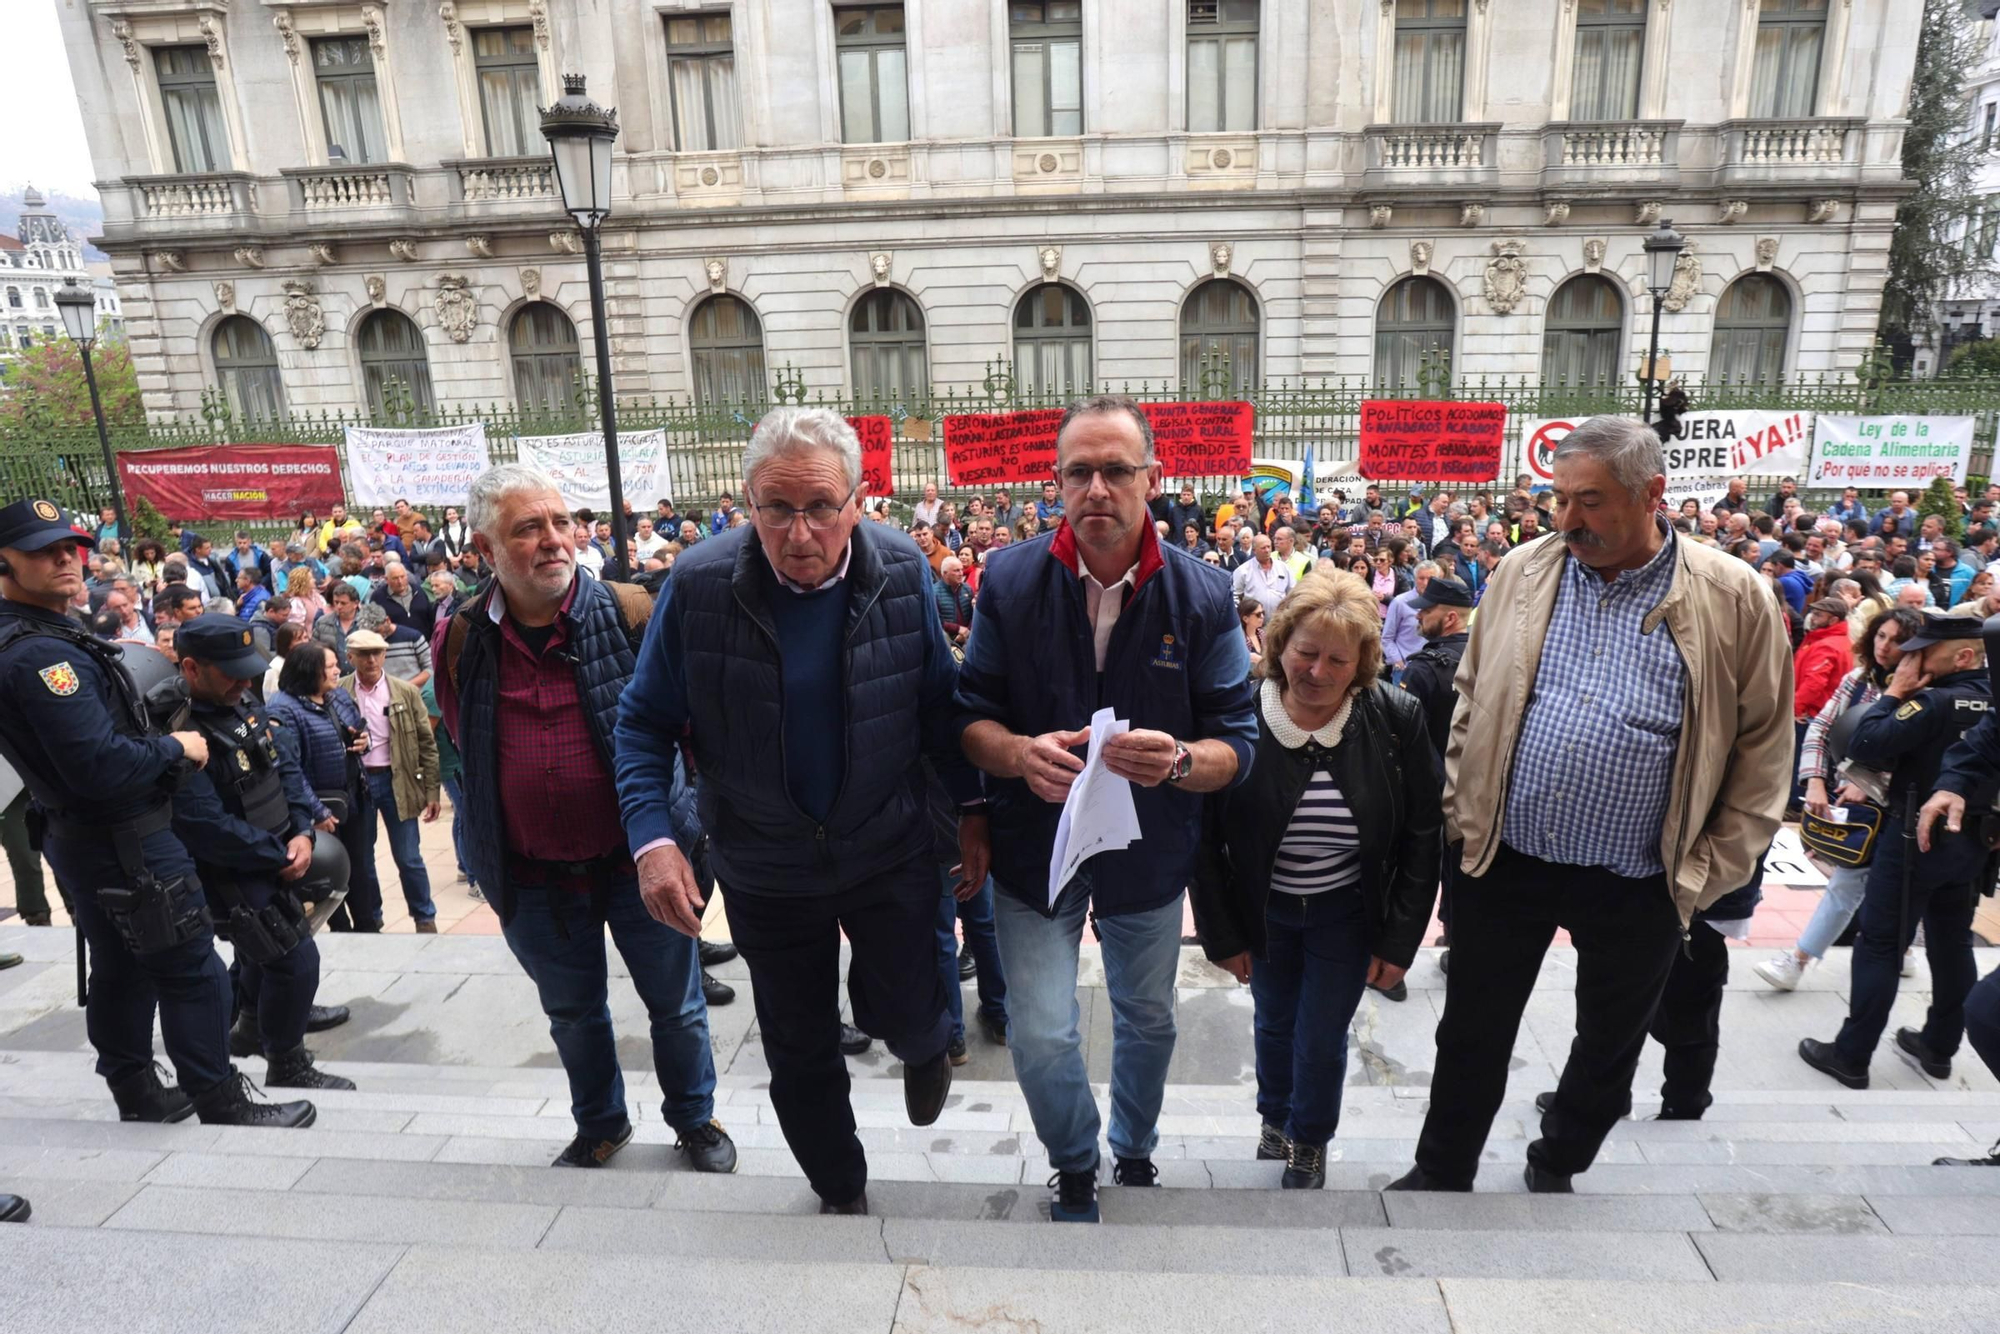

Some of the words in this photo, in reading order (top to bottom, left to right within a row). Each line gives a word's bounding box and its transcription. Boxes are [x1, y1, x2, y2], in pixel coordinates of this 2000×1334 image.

[1154, 405, 1187, 416] JUNTA
[1191, 404, 1242, 416] GENERAL
[1155, 417, 1192, 429] LEGISLA
[1195, 416, 1234, 426] CONTRA
[360, 430, 406, 440] PARQUE
[417, 428, 472, 438] NACIONAL
[1200, 426, 1240, 437] RURAL
[1858, 421, 1882, 439] Ley
[1890, 421, 1907, 437] de
[1915, 421, 1929, 437] la
[371, 439, 415, 449] PARQUE
[525, 438, 543, 449] NO
[547, 438, 559, 448] ES
[563, 435, 605, 447] ASTURIA
[1822, 440, 1871, 457] Cadena
[1879, 441, 1960, 457] Alimentaria
[361, 452, 373, 462] EL
[387, 452, 413, 463] PLAN
[419, 452, 431, 461] DE
[536, 451, 550, 463] ES
[559, 449, 606, 462] ASTURIA
[952, 443, 1006, 464] ASTURIAS
[1009, 443, 1020, 455] ES
[1367, 444, 1429, 459] MONTES
[1001, 456, 1018, 466] NO
[1663, 447, 1728, 470] SPRE
[126, 462, 209, 475] RECUPEREMOS
[210, 463, 269, 475] NUESTROS
[271, 463, 331, 475] DERECHOS
[374, 462, 390, 472] 20
[402, 461, 428, 472] AÑOS
[574, 467, 590, 477] AL
[1815, 461, 1843, 481] ¿Por
[1847, 461, 1870, 480] qué
[1873, 465, 1890, 477] no
[1893, 465, 1908, 477] se
[1911, 461, 1958, 481] aplica?
[373, 475, 382, 484] A
[390, 474, 404, 484] LA
[957, 466, 1006, 482] RESERVA
[376, 485, 386, 496] A
[392, 484, 407, 495] LA
[416, 480, 469, 495] EXTINCIÓ
[1694, 481, 1727, 491] Cabras
[1152, 658, 1180, 670] ASTURIAS
